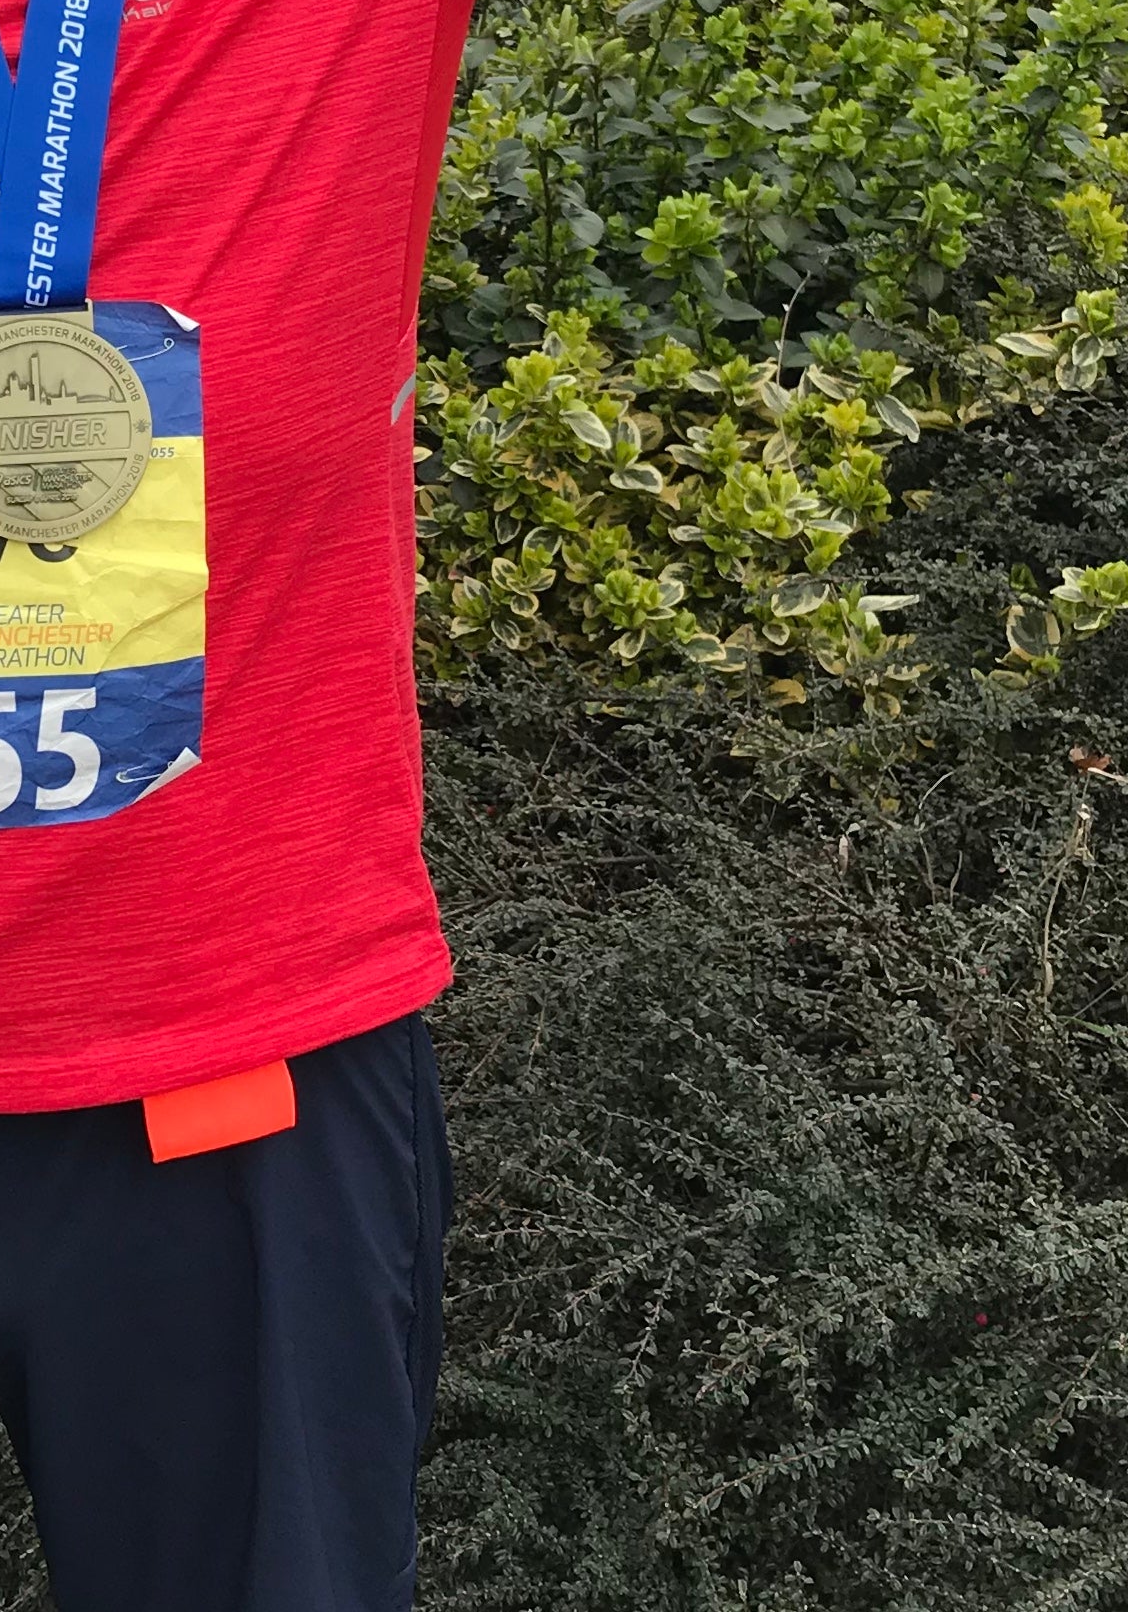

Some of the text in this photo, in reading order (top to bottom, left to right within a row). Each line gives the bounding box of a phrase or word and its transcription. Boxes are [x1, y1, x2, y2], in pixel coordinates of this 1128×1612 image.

[37, 59, 80, 218] MARATHON
[24, 221, 59, 308] ESTER
[71, 331, 126, 375] MARATHON
[121, 374, 141, 402] 2018
[150, 446, 175, 458] 055
[3, 522, 79, 538] MANCHESTER
[81, 481, 132, 528] MARATHON
[126, 453, 145, 481] 2018
